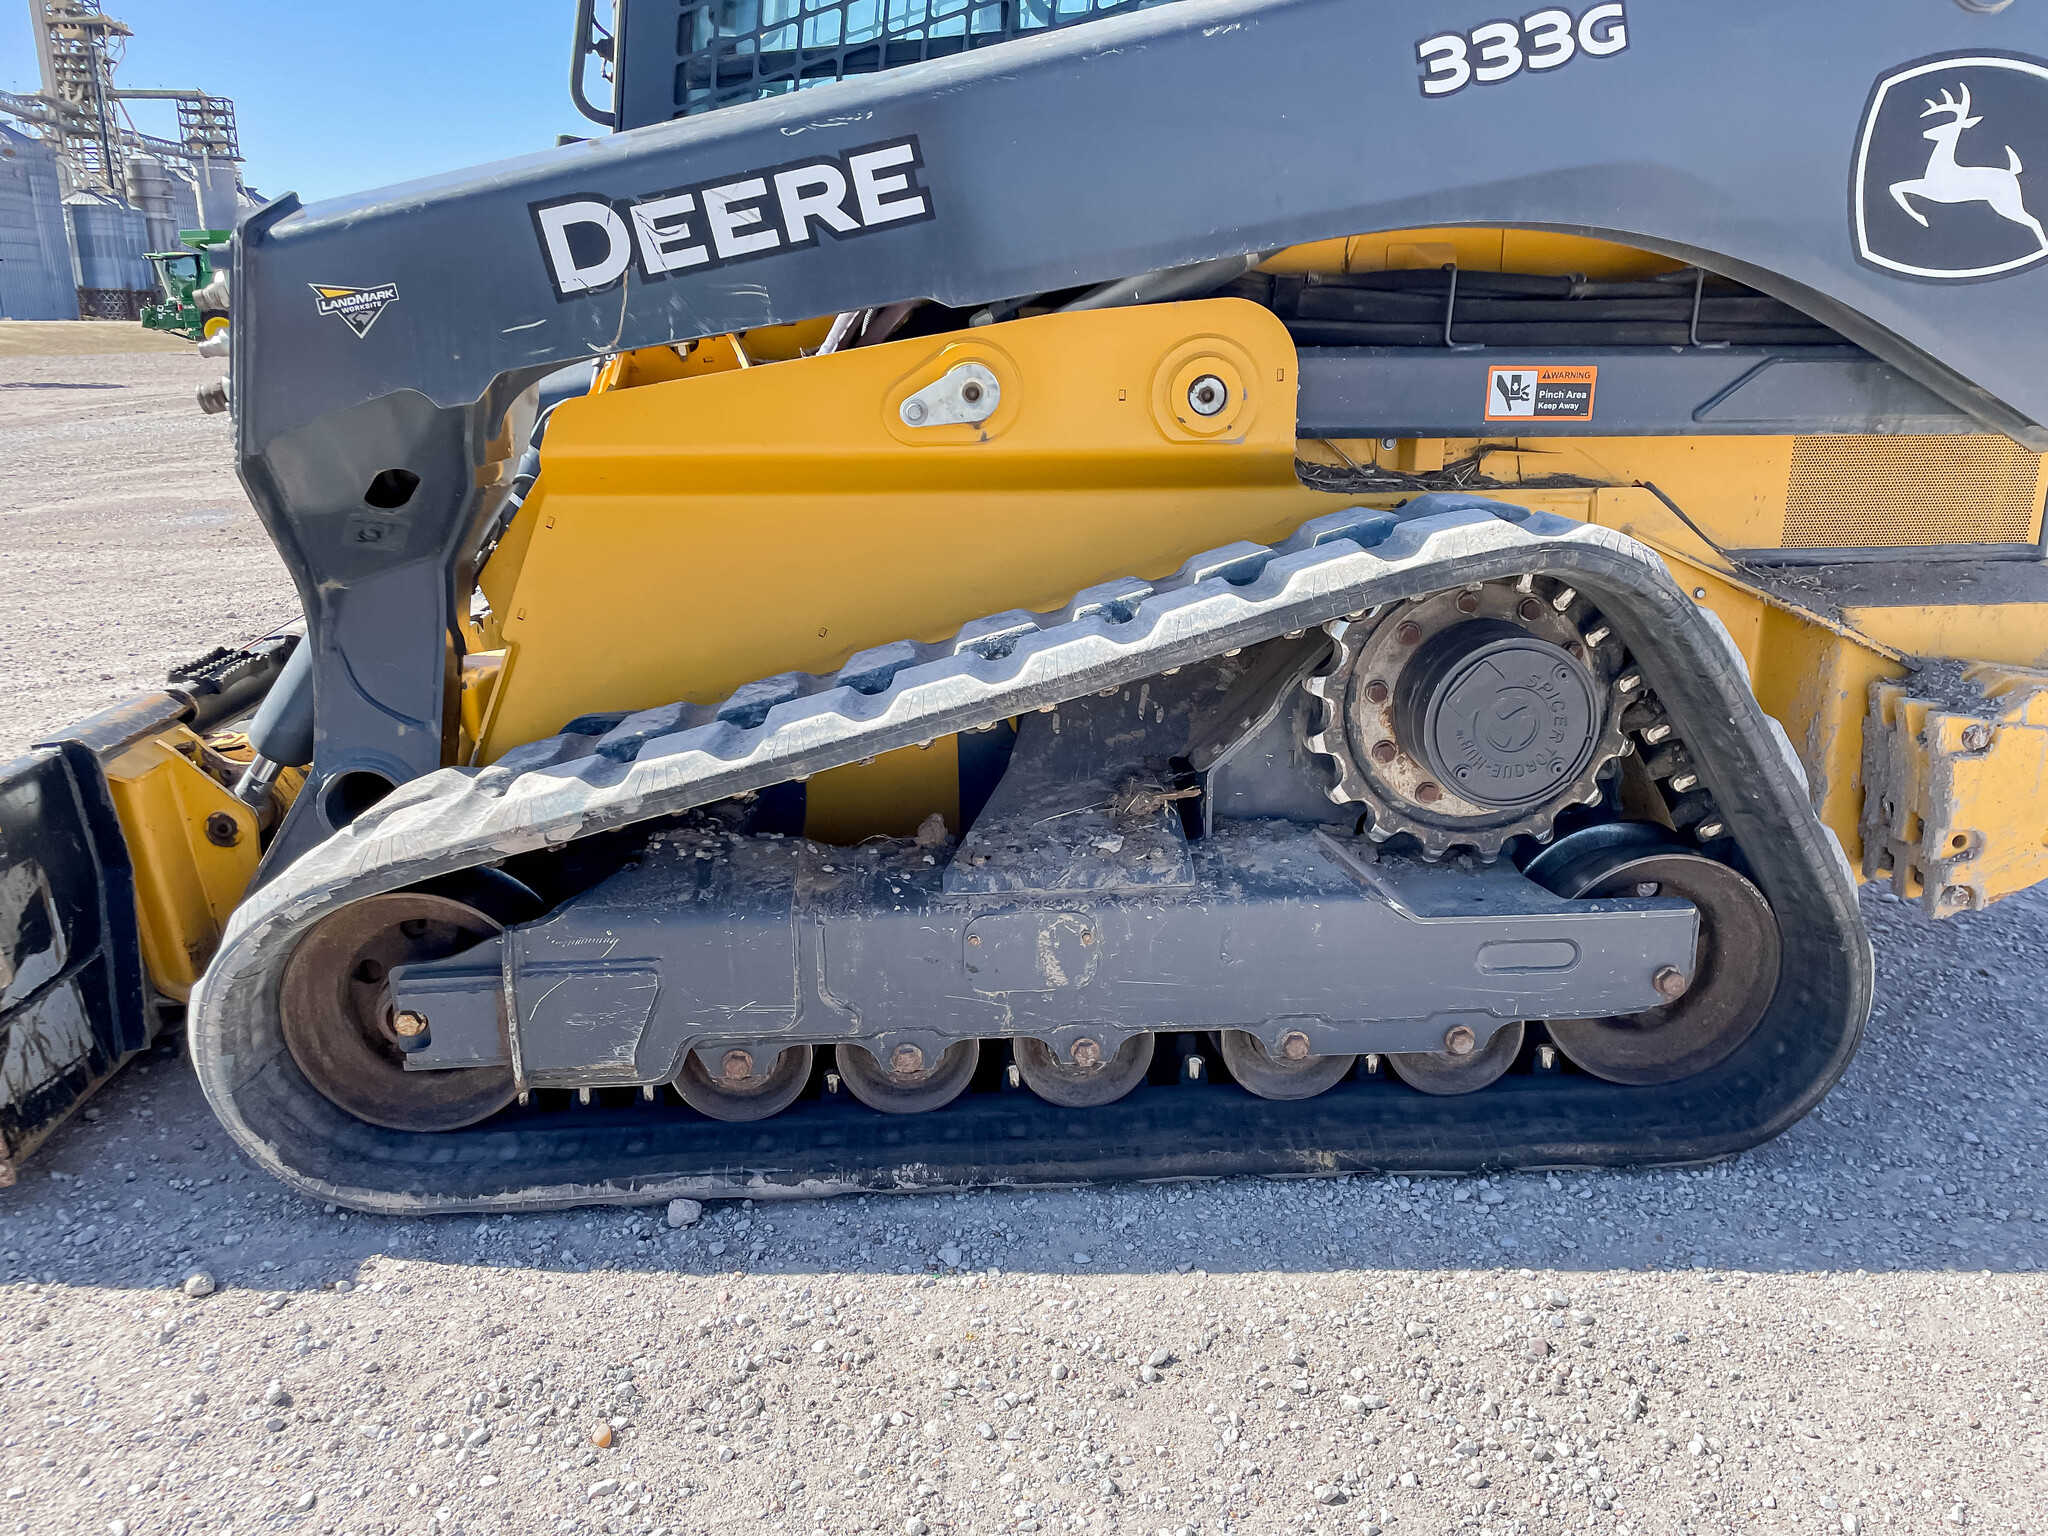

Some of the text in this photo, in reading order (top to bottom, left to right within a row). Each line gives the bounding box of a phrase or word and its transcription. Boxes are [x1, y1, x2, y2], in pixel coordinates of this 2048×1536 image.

[1419, 4, 1627, 94] 333G
[538, 144, 926, 294] DEERE
[321, 289, 395, 311] LANDMARK
[341, 301, 382, 314] WORKSITE
[1551, 371, 1591, 379] WARNING
[1539, 389, 1587, 399] Pinch Area
[1537, 402, 1580, 411] Keep Away
[1525, 674, 1568, 744] SPICER
